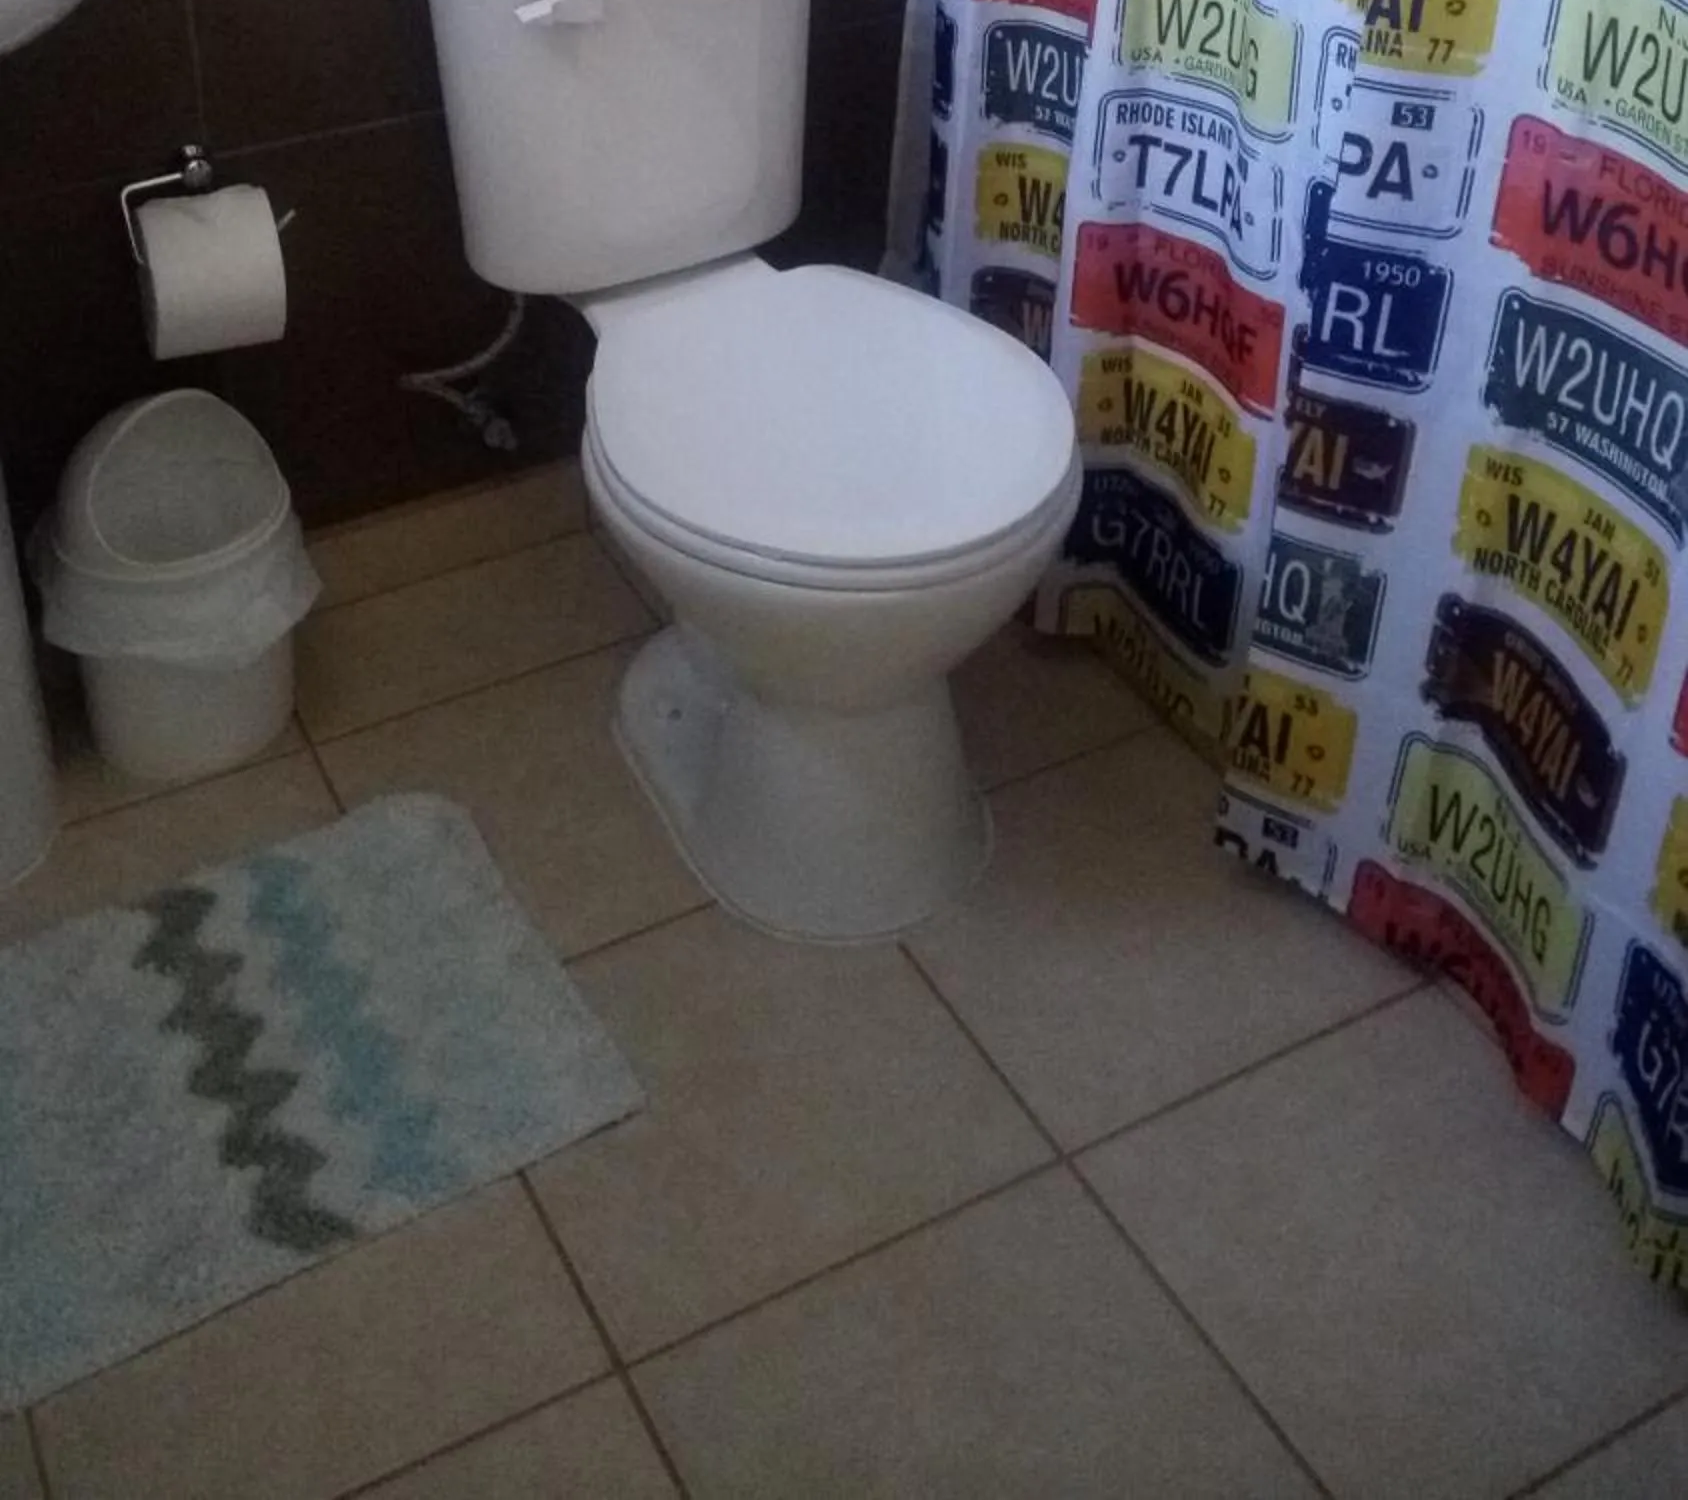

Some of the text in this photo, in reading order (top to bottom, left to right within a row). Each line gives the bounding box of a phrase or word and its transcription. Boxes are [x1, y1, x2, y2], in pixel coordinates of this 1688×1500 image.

[1426, 37, 1457, 64] 77
[1006, 38, 1081, 108] W2U
[1557, 76, 1588, 109] USA
[1116, 101, 1176, 130] RHODE
[995, 151, 1028, 169] WIS
[1361, 259, 1422, 288] 1950
[1101, 355, 1133, 374] WIS
[1514, 317, 1686, 472] W2UHQ
[1547, 410, 1570, 434] 57
[1485, 456, 1525, 487] WIS
[1584, 507, 1617, 543] JAN
[1473, 546, 1542, 592] NORTH
[1507, 493, 1640, 643] W4YAI
